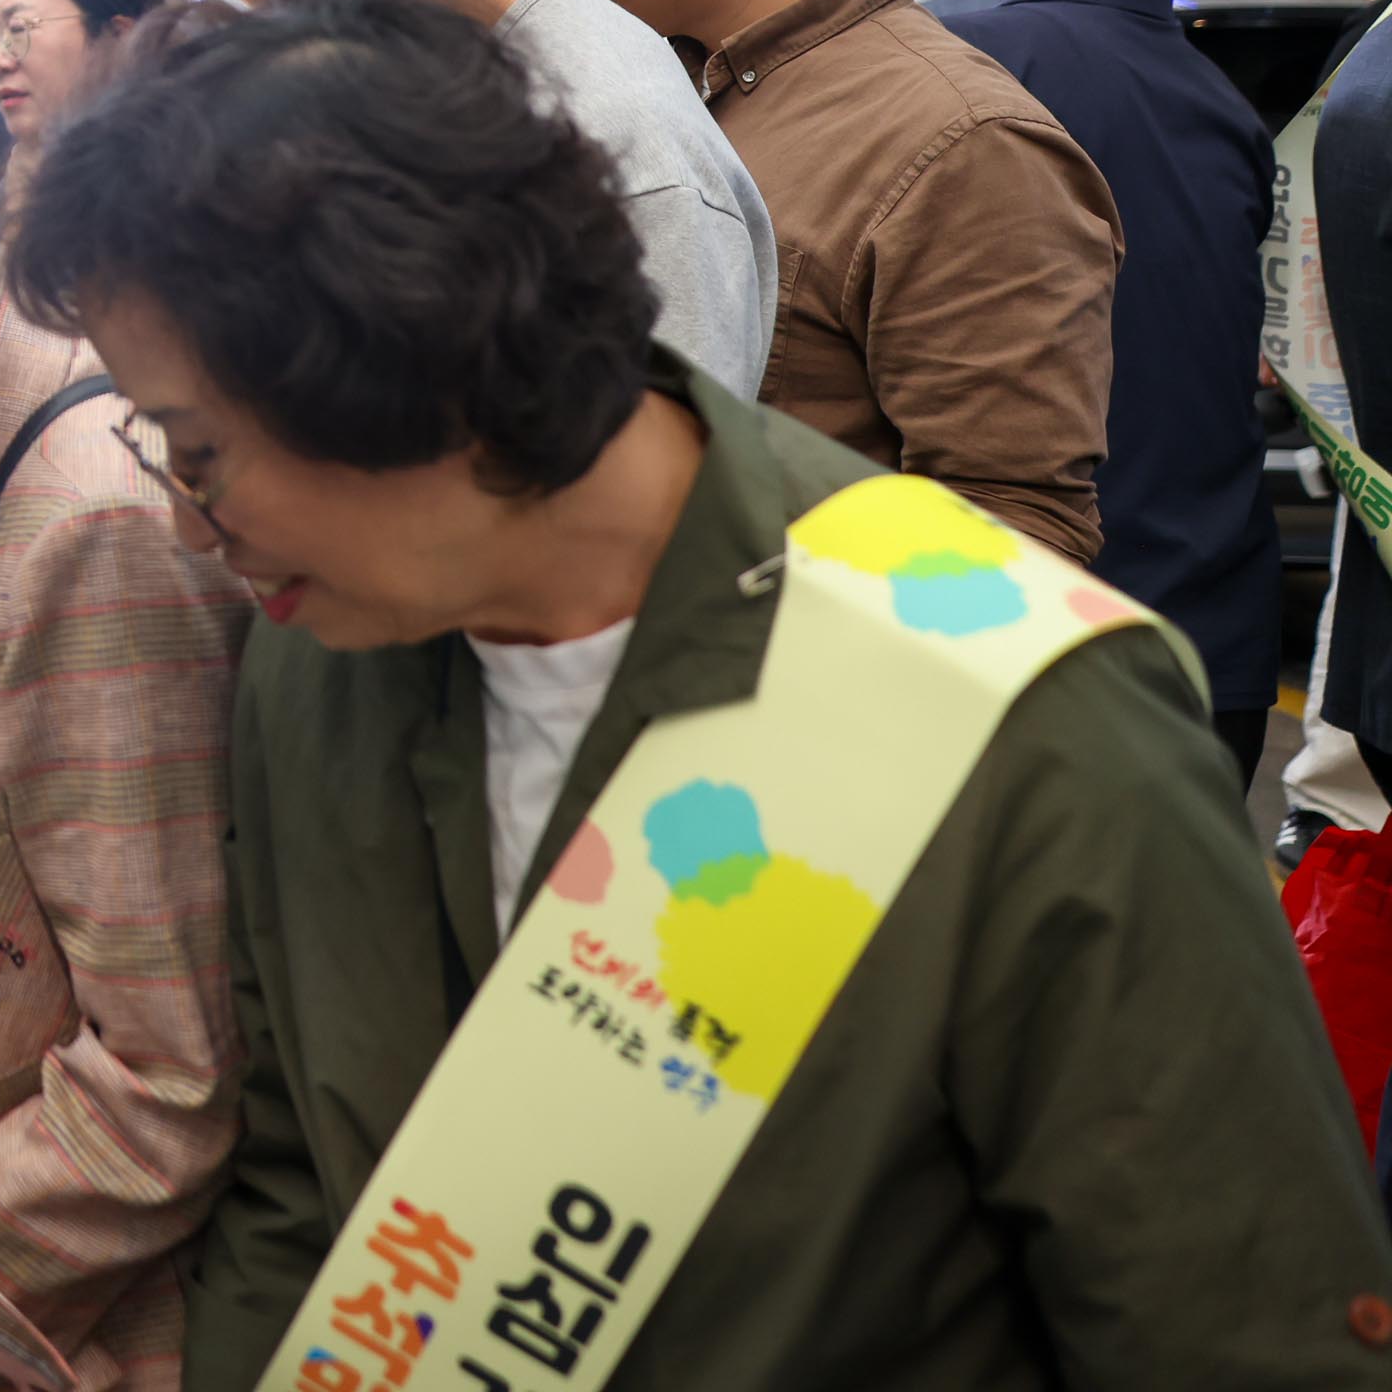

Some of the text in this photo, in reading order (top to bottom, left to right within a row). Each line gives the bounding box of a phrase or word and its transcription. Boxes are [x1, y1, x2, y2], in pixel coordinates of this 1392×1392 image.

[526, 963, 722, 1116] 도약하는 영주
[486, 1181, 652, 1378] 인심
